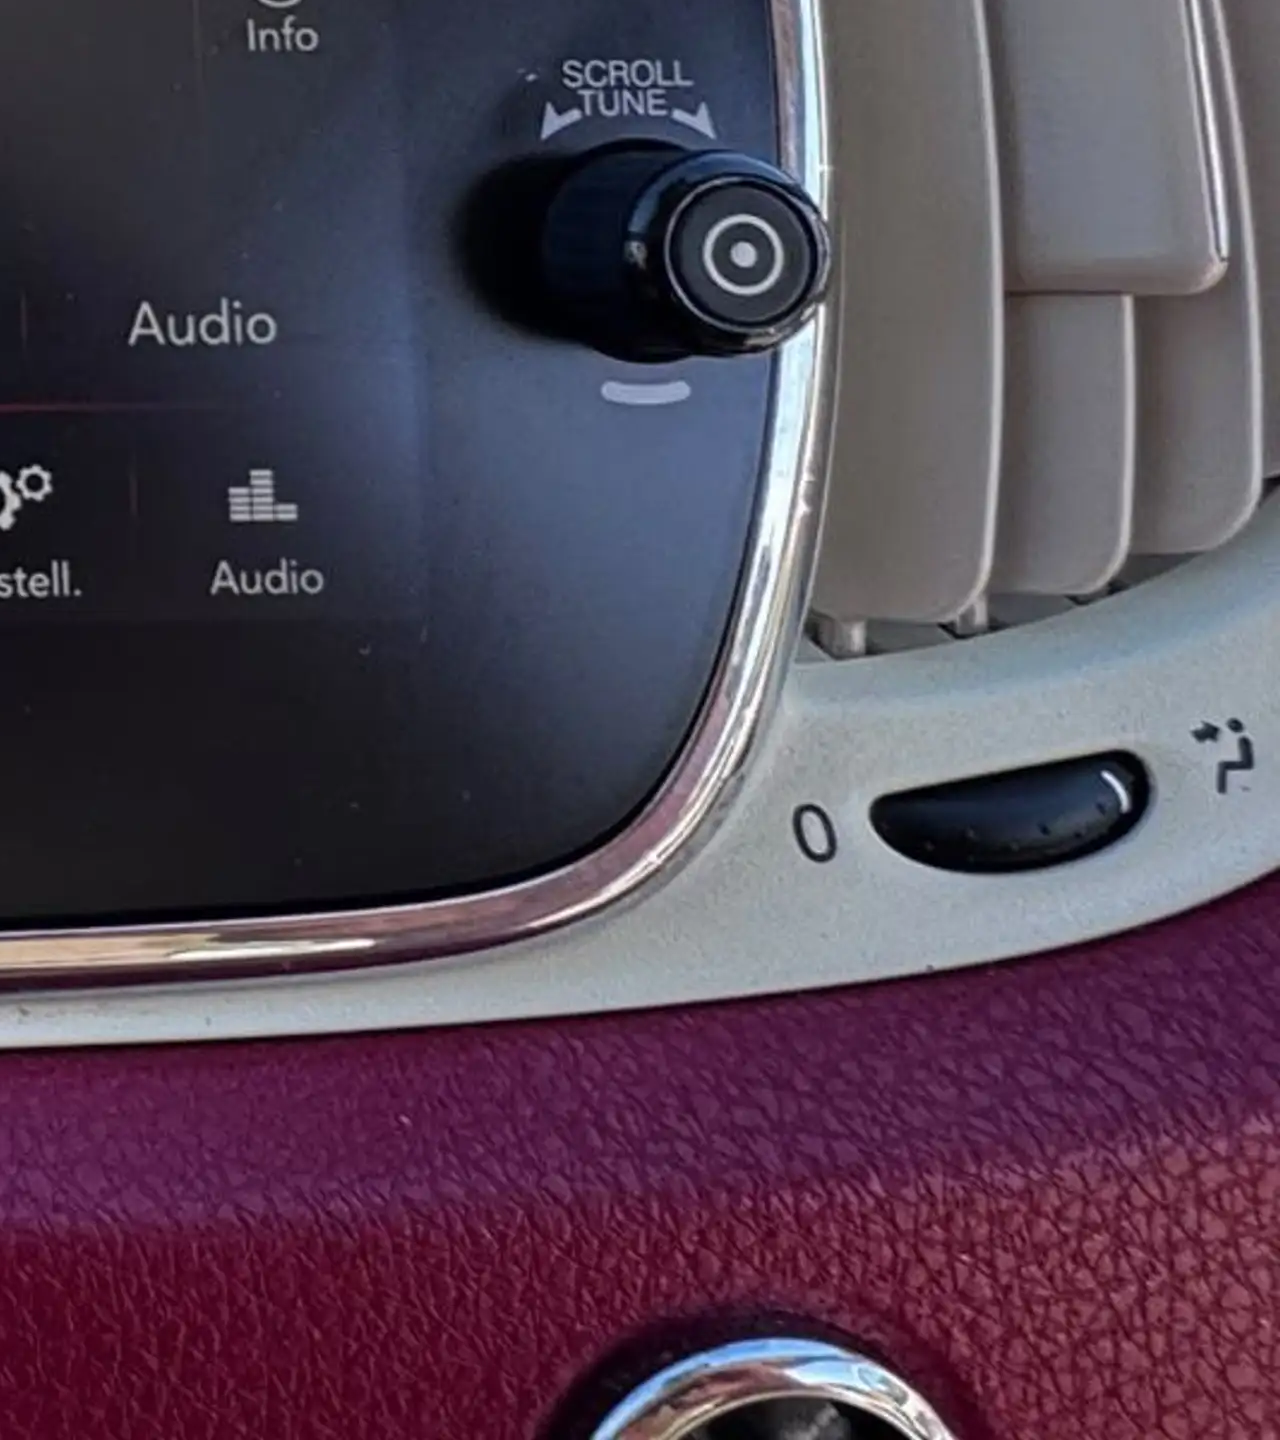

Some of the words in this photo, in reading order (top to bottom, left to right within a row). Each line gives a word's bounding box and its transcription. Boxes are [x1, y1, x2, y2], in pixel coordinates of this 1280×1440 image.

[246, 18, 320, 52] Info
[562, 60, 694, 90] SCROLL
[580, 90, 668, 119] TUNE
[128, 298, 278, 347] Audio
[209, 559, 325, 596] Audio
